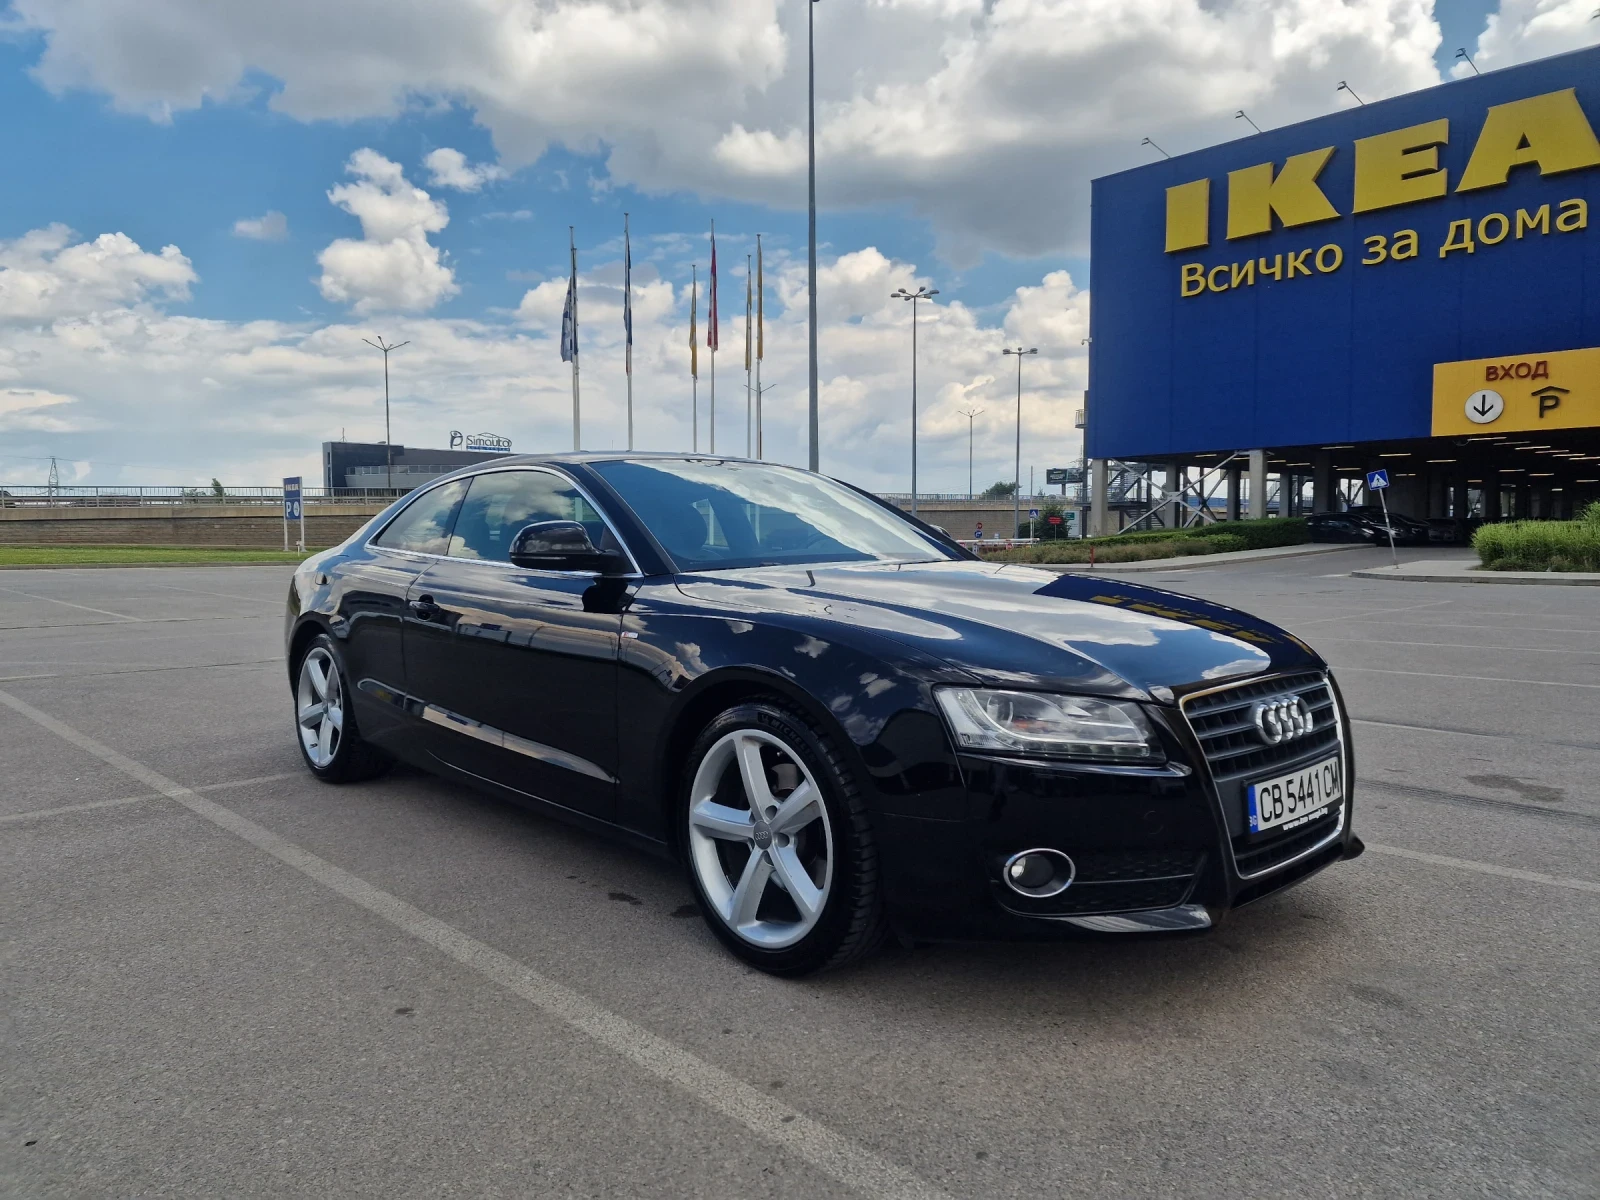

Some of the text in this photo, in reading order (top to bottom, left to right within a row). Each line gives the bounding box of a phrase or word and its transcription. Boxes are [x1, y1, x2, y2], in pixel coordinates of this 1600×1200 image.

[1164, 87, 1600, 253] IKEA
[1180, 198, 1588, 298] Всичко за дома
[1486, 360, 1549, 382] ВХОД
[1286, 769, 1321, 813] 5441
